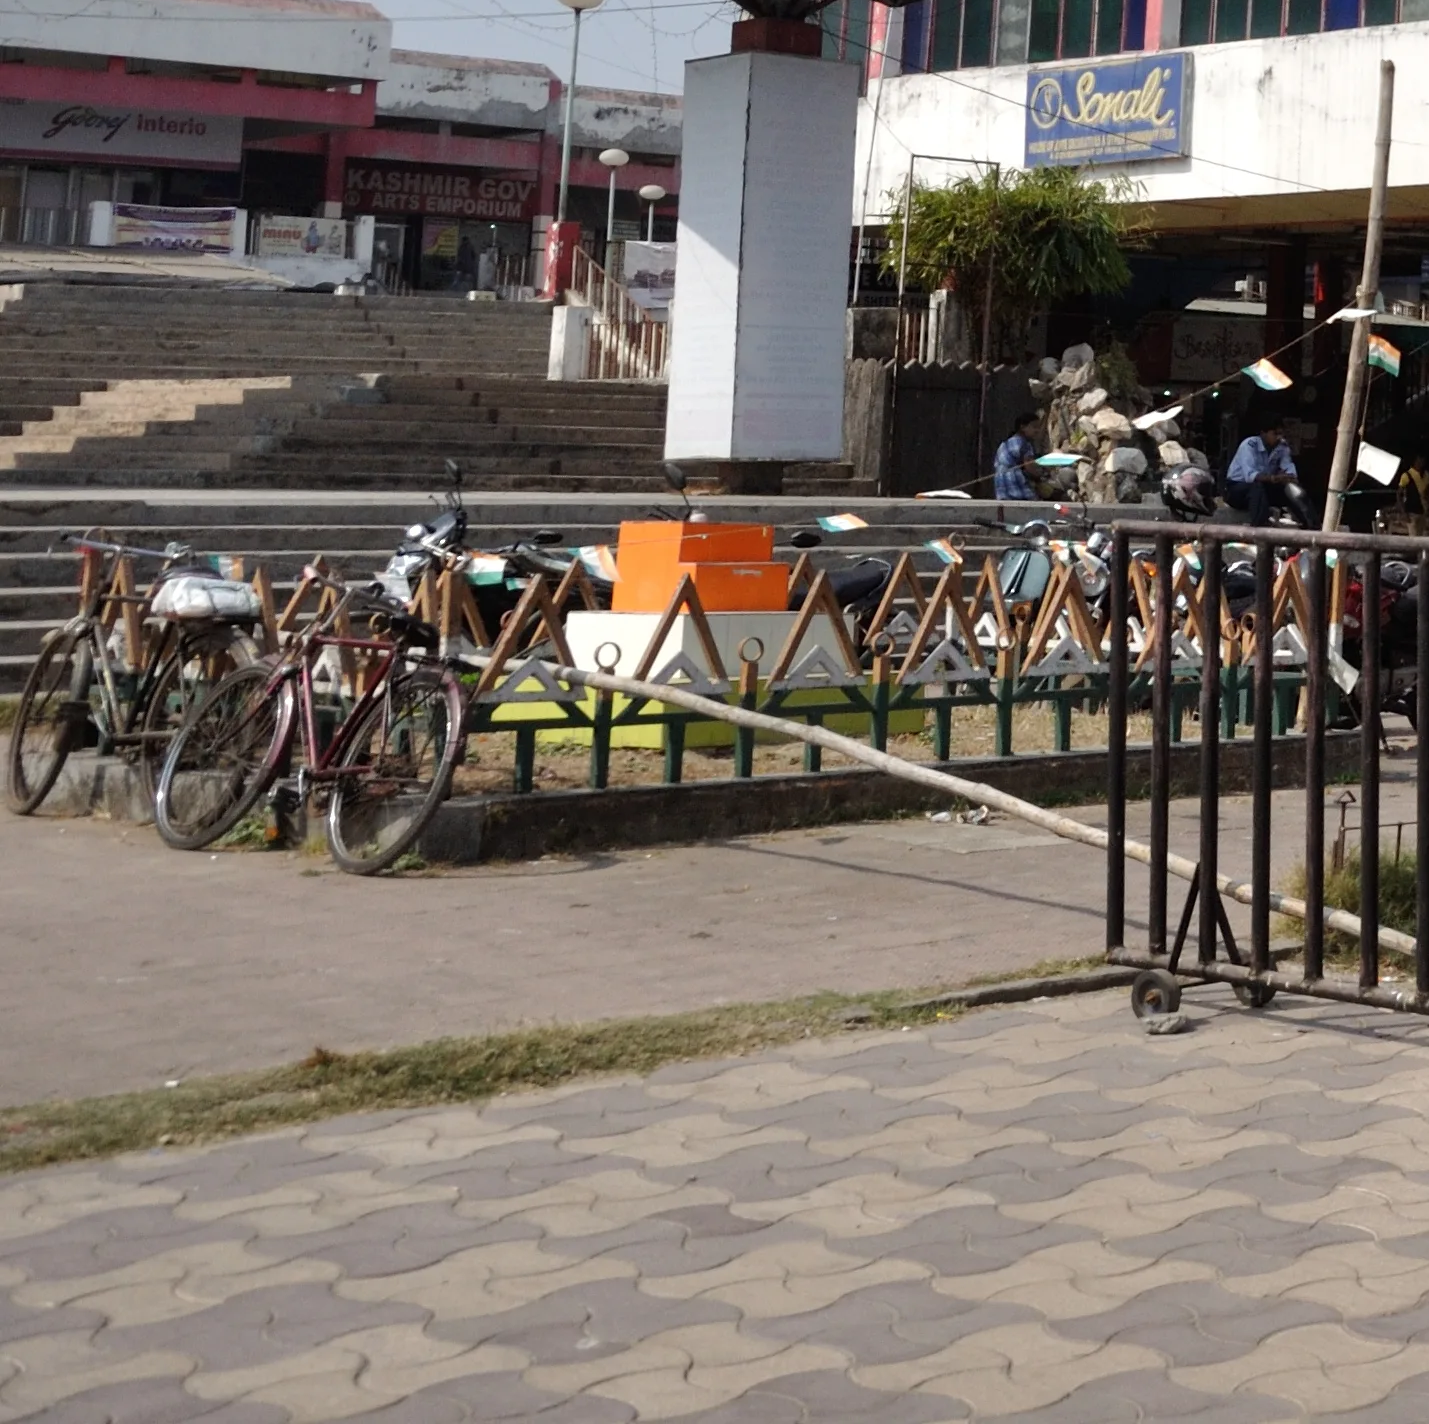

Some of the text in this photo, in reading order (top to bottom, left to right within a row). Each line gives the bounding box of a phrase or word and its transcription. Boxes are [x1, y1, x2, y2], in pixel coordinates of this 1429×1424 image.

[1063, 66, 1175, 126] Sonali
[137, 113, 208, 137] interio
[346, 168, 470, 198] KASHMIR
[371, 192, 523, 218] ARTS EMPORIUM
